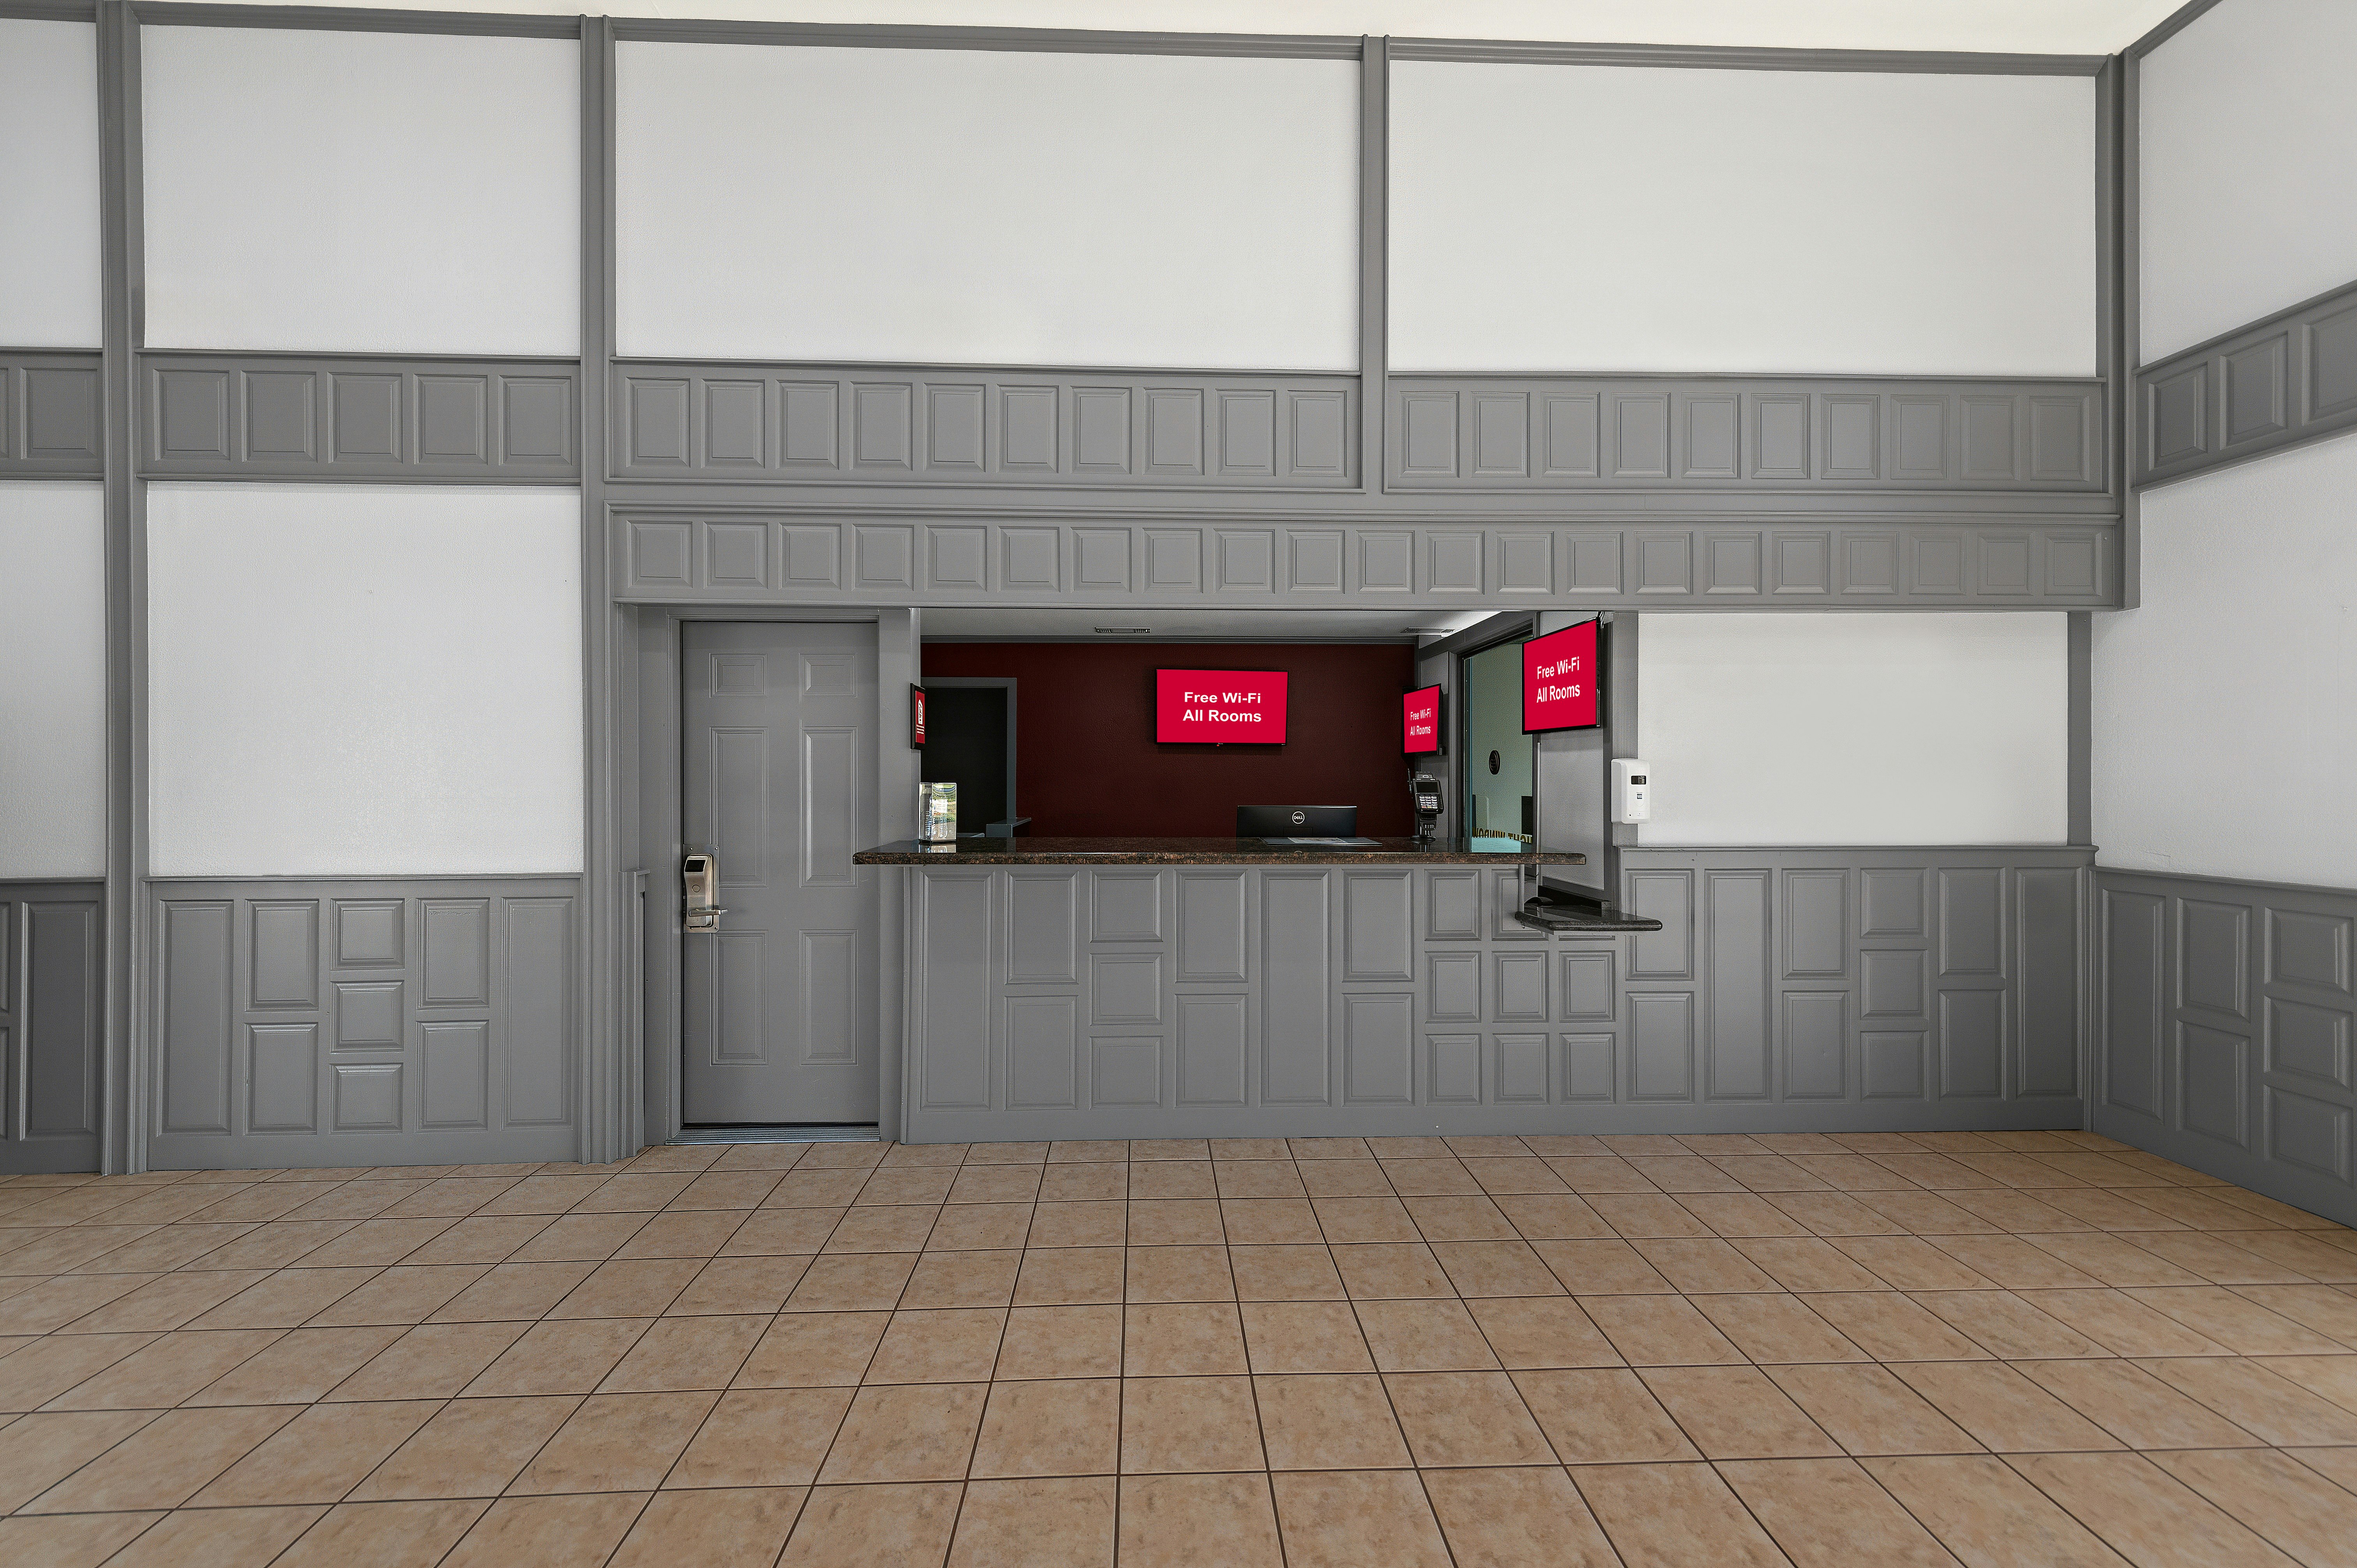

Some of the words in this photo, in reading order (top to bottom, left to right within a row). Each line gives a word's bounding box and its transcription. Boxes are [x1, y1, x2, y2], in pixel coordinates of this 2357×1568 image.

[1537, 666, 1555, 680] Free
[1557, 656, 1580, 675] Wi-Fi
[1184, 692, 1217, 703] Free
[1222, 692, 1261, 703] Wi-Fi
[1536, 687, 1547, 703] All
[1550, 684, 1580, 701] Rooms
[1182, 709, 1203, 721] All
[1209, 710, 1262, 722] Rooms
[1410, 711, 1419, 721] Free
[1420, 708, 1431, 719] Wi-Fi
[1416, 726, 1431, 735] Rooms
